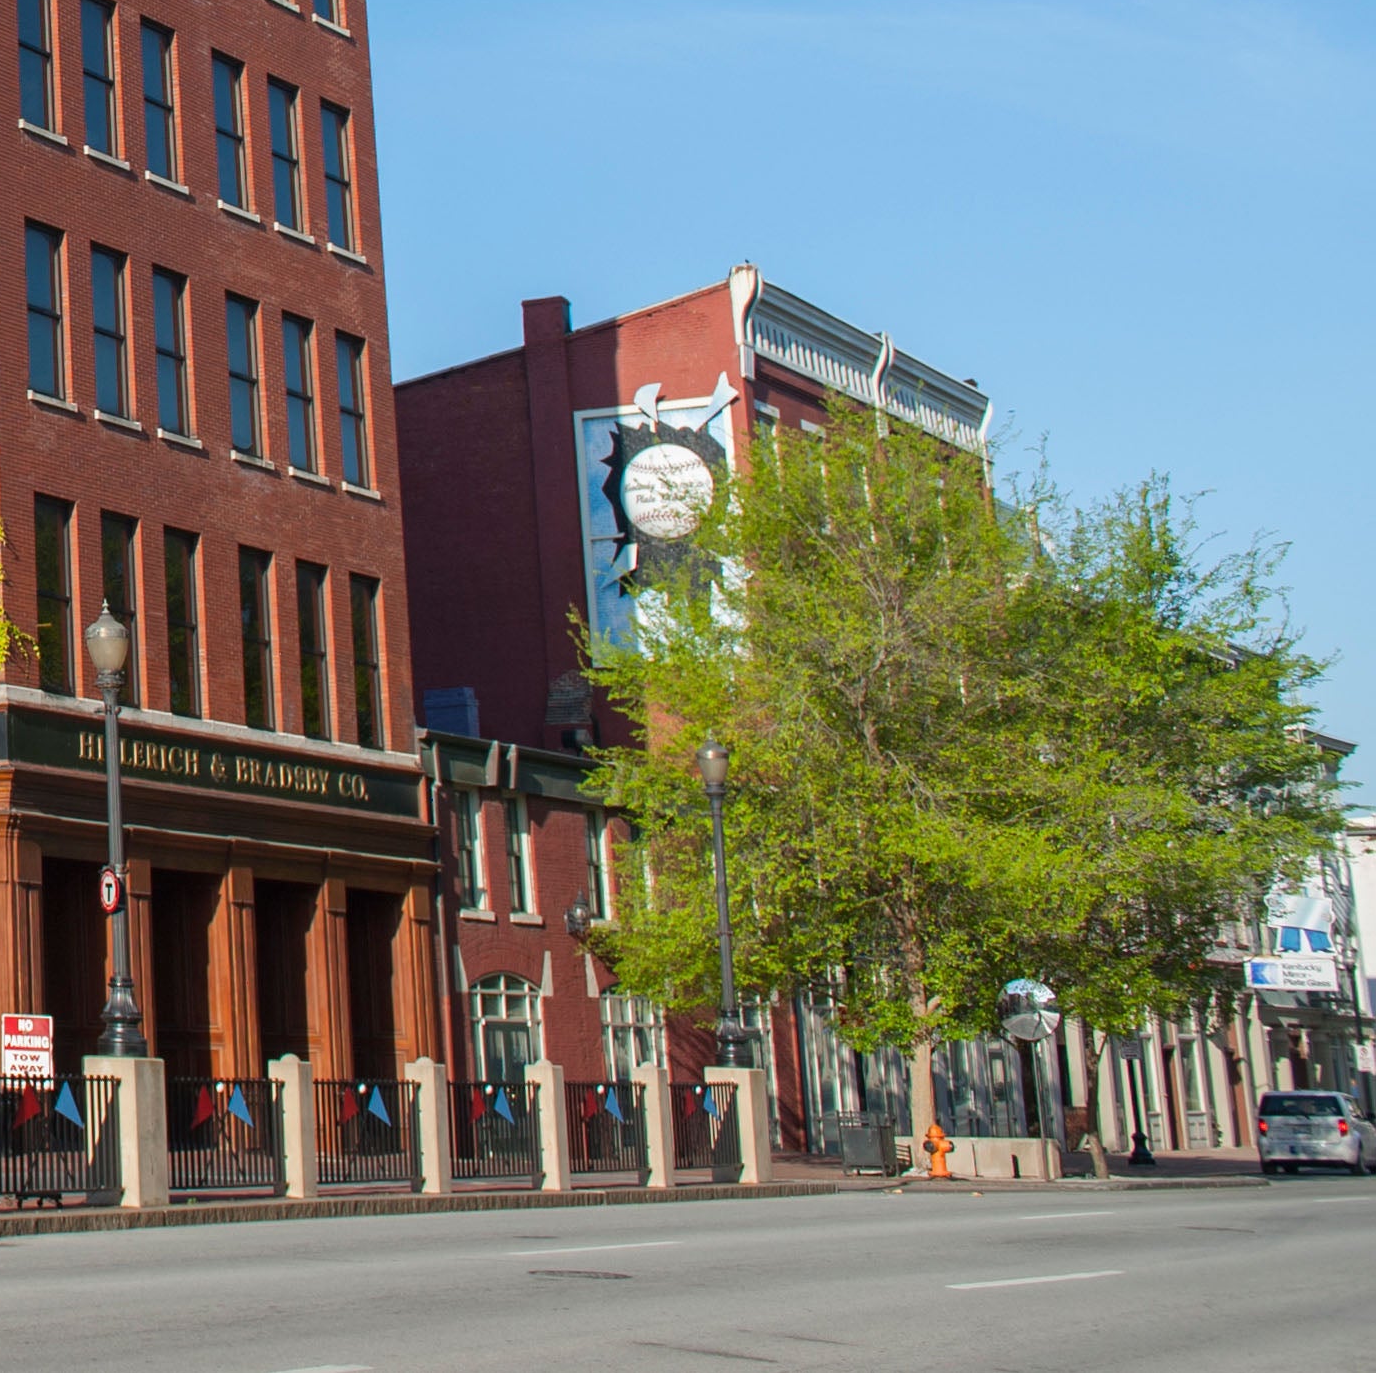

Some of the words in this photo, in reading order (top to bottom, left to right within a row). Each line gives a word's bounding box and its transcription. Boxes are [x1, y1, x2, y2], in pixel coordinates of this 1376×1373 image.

[79, 731, 200, 776] HILERICH
[210, 753, 227, 782] &
[235, 755, 330, 795] BRADSBY
[338, 772, 369, 802] CO.
[104, 883, 113, 902] T
[1282, 962, 1321, 972] Kentucky
[1283, 978, 1306, 986] Plate
[1307, 979, 1331, 987] Glass
[18, 1019, 34, 1032] NO
[5, 1034, 49, 1049] PARKING
[13, 1053, 40, 1062] TOW
[10, 1064, 44, 1072] AWAY
